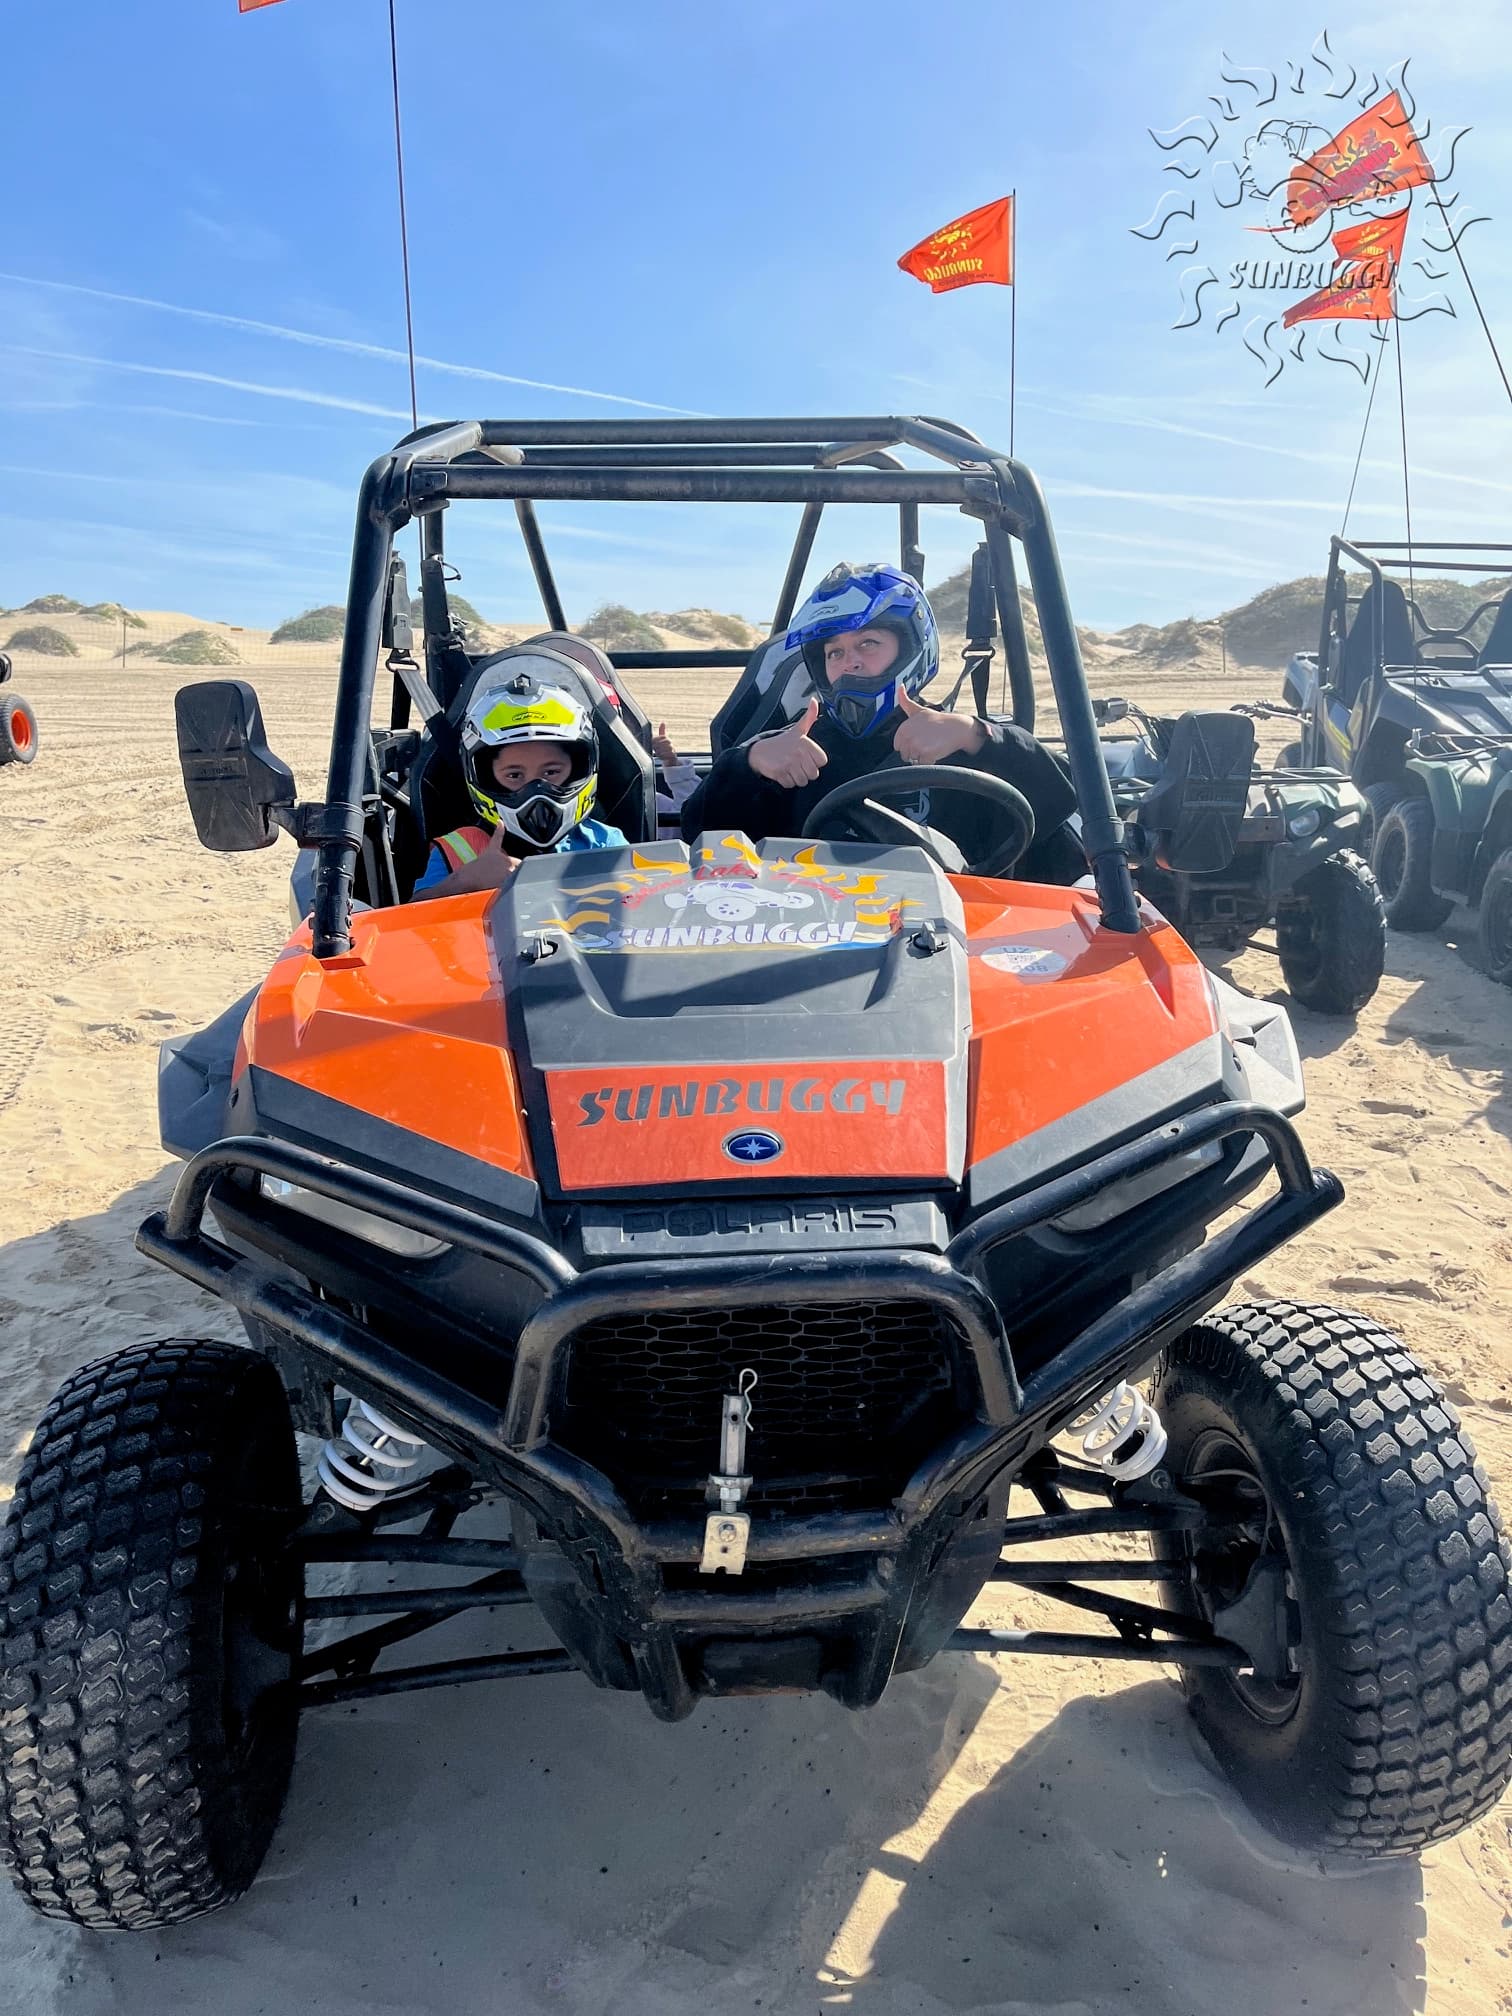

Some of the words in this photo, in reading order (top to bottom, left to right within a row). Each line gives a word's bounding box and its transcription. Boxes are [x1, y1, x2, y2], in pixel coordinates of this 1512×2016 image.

[603, 921, 858, 949] SUNBUGGY
[577, 1078, 906, 1127] SUNBUGGY
[620, 1203, 896, 1243] POLARIS
